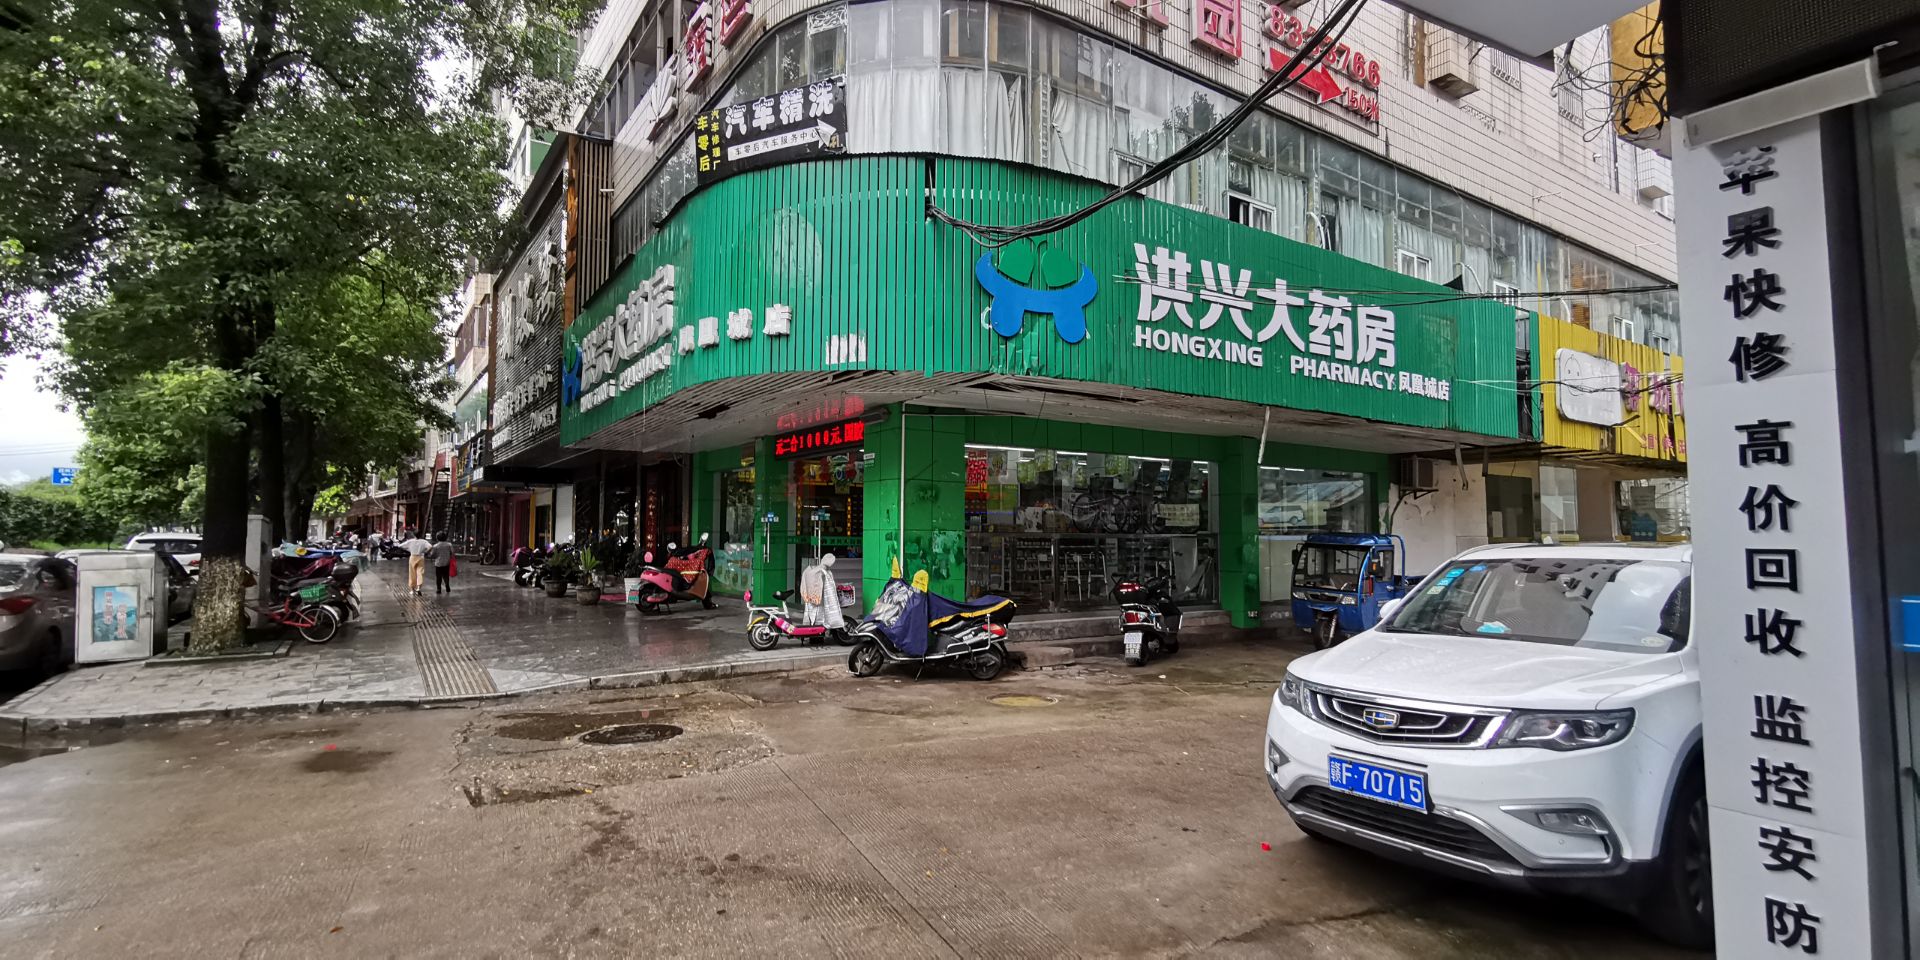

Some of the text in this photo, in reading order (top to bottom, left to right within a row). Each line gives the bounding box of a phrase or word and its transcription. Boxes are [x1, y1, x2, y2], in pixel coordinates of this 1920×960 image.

[697, 116, 711, 171] 车零后
[711, 110, 721, 170] 汽车修理厂
[725, 81, 834, 139] 汽车精洗
[734, 129, 818, 156] 车零后汽车服务中心
[1134, 243, 1395, 367] 洪兴大药房
[1134, 325, 1450, 401] HONGXING PHARMACY 凤凰城店
[1734, 418, 1805, 657] 高价回收
[1751, 694, 1821, 954] 监控安防
